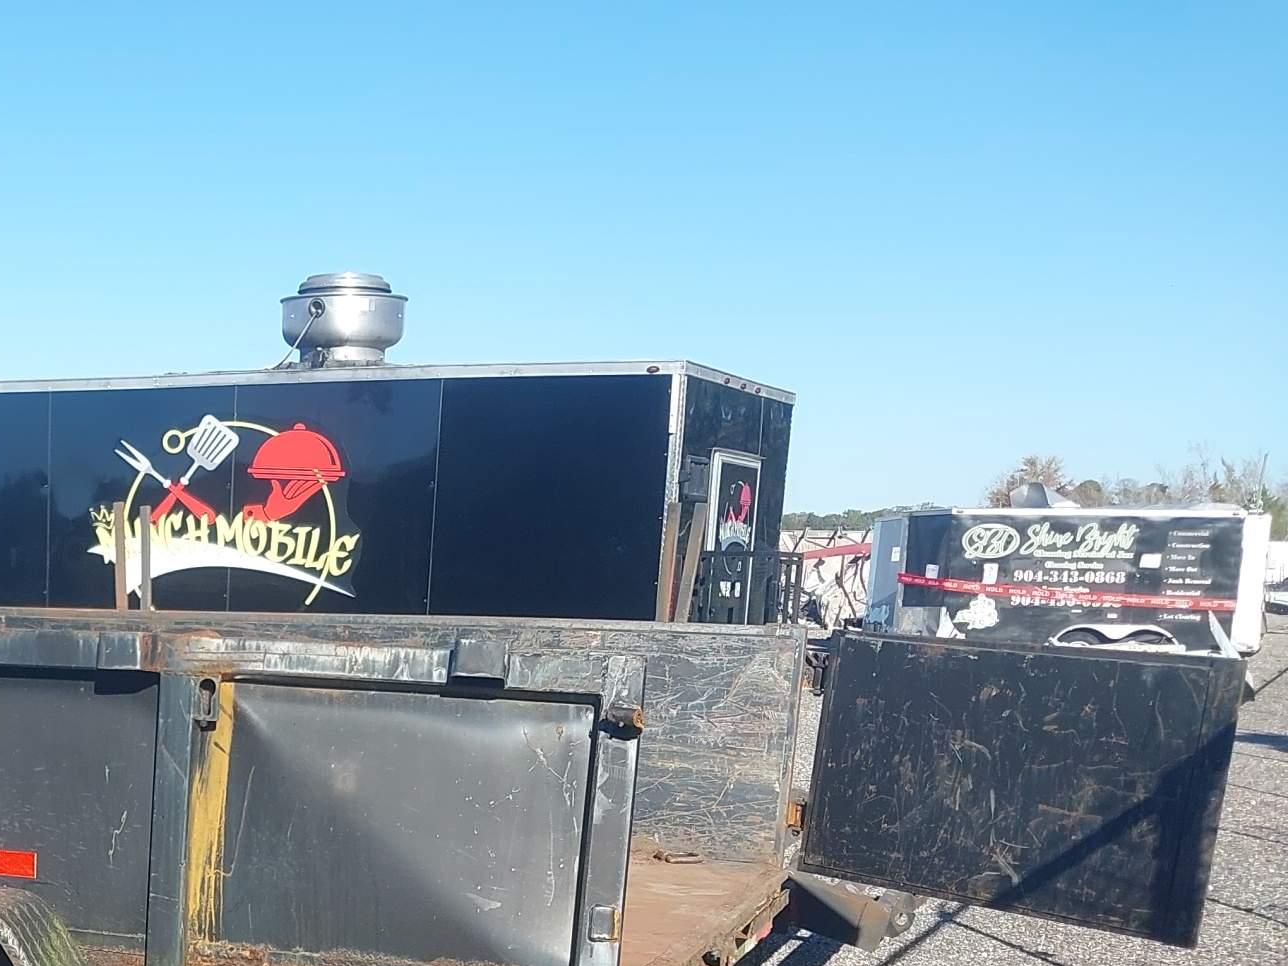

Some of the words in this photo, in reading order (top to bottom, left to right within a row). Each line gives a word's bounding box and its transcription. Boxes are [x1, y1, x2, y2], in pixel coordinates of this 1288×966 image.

[1019, 522, 1074, 555] Shine
[1075, 522, 1140, 554] Bright
[1013, 569, 1127, 584] 904-343-0868
